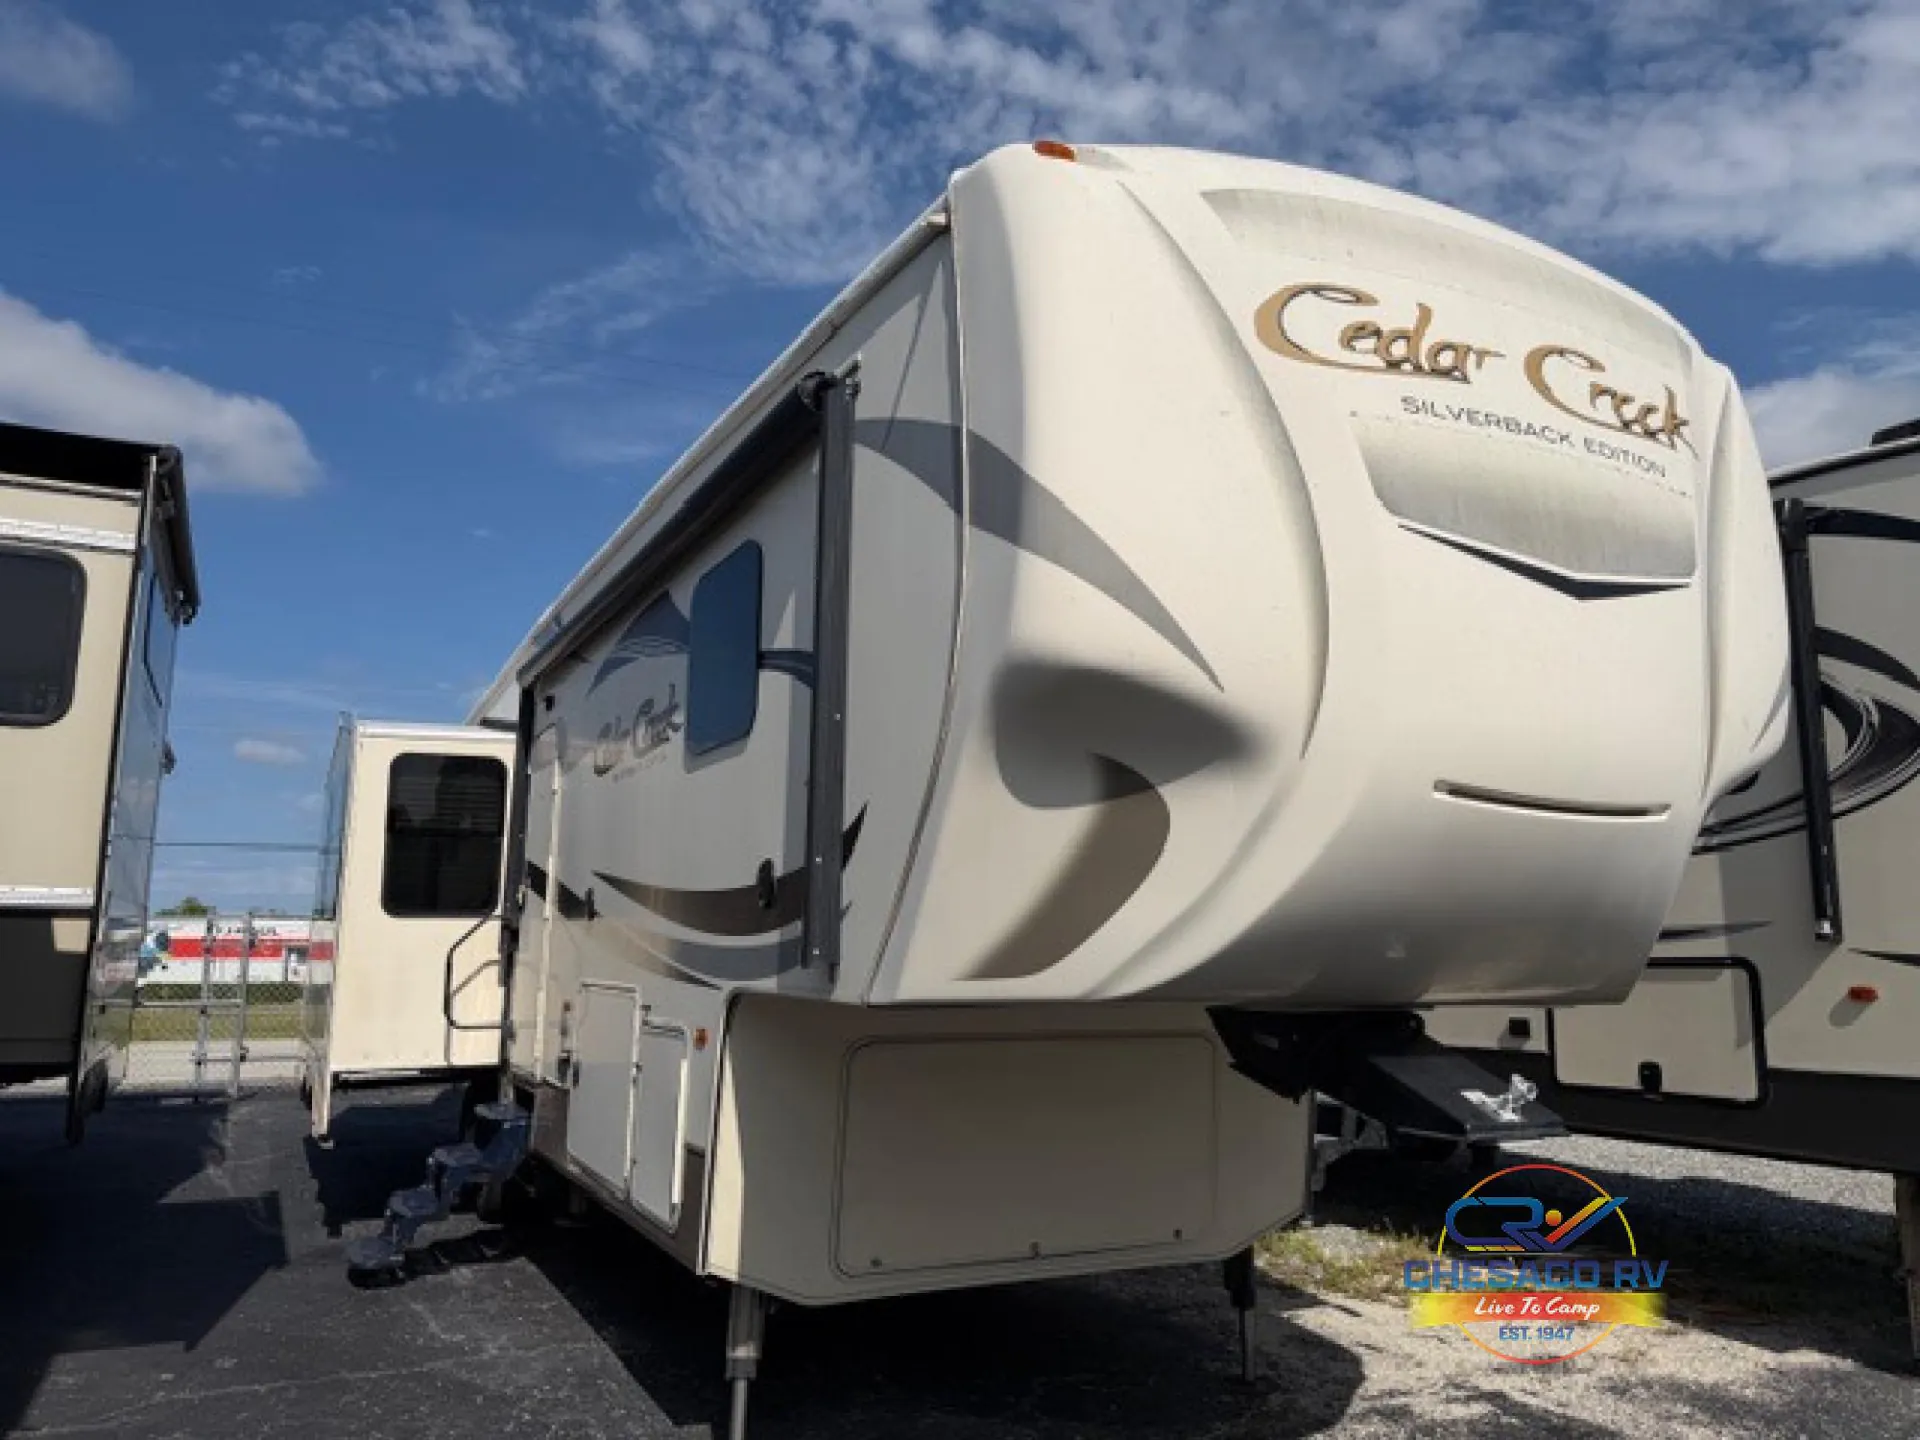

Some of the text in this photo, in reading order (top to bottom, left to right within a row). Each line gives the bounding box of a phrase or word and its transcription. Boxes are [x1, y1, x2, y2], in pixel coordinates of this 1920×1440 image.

[1254, 283, 1699, 459] Cedar Creek
[1400, 395, 1667, 478] SILVERBACK EDITION
